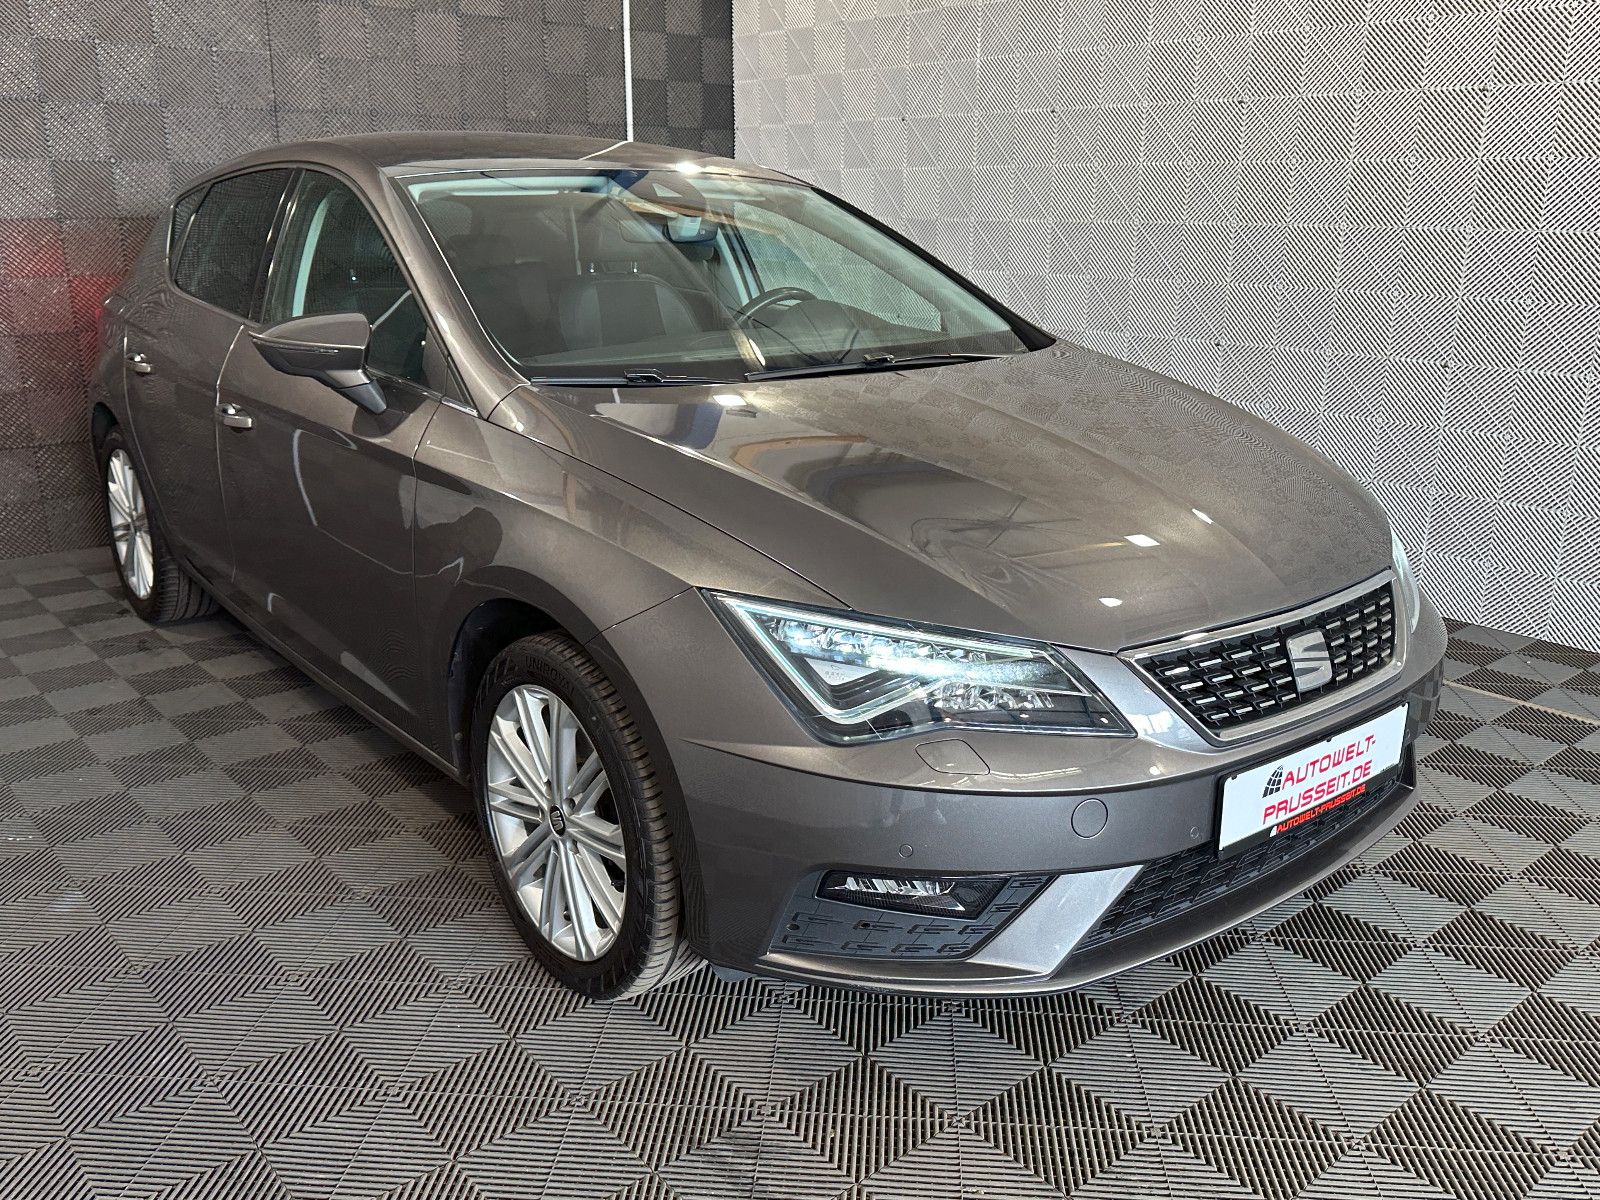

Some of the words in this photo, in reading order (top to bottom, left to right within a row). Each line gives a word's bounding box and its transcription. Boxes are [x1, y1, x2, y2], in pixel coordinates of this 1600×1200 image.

[1281, 734, 1376, 790] AUTOWELT-
[1262, 759, 1373, 825] PRUSSEIT.DE
[1276, 784, 1366, 833] AUTOWELT-PRUSSEIT.DE
